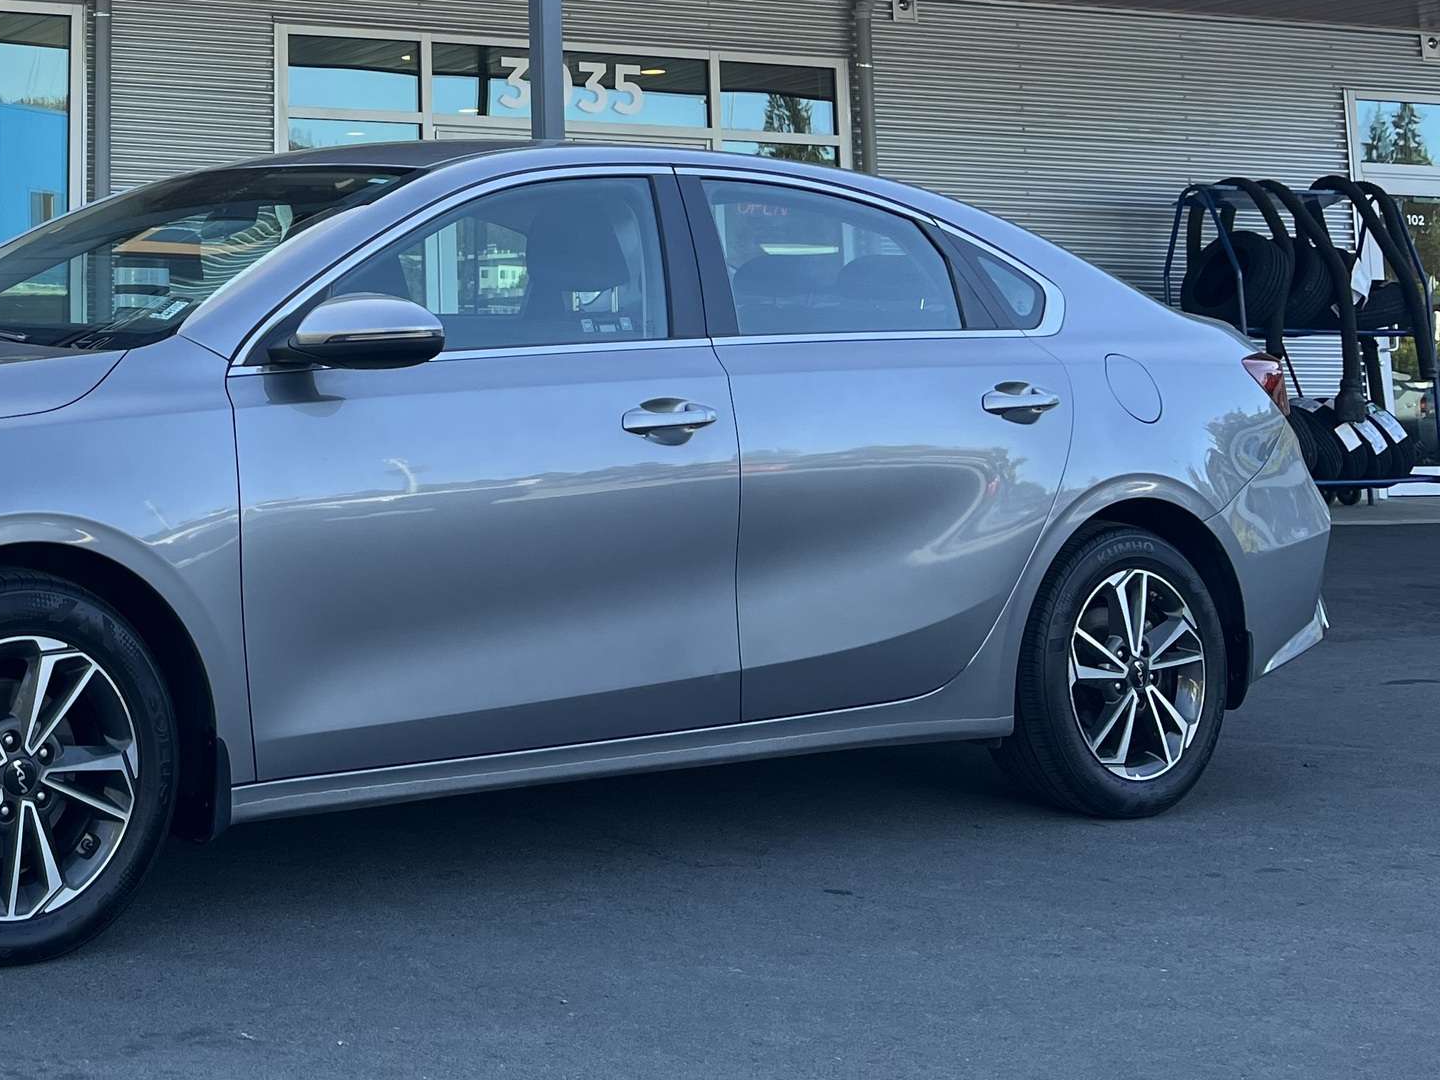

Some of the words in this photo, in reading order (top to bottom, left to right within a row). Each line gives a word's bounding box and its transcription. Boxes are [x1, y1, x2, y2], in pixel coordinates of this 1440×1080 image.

[498, 56, 644, 116] 335
[1406, 214, 1425, 226] 102
[1097, 540, 1156, 565] KUMHO
